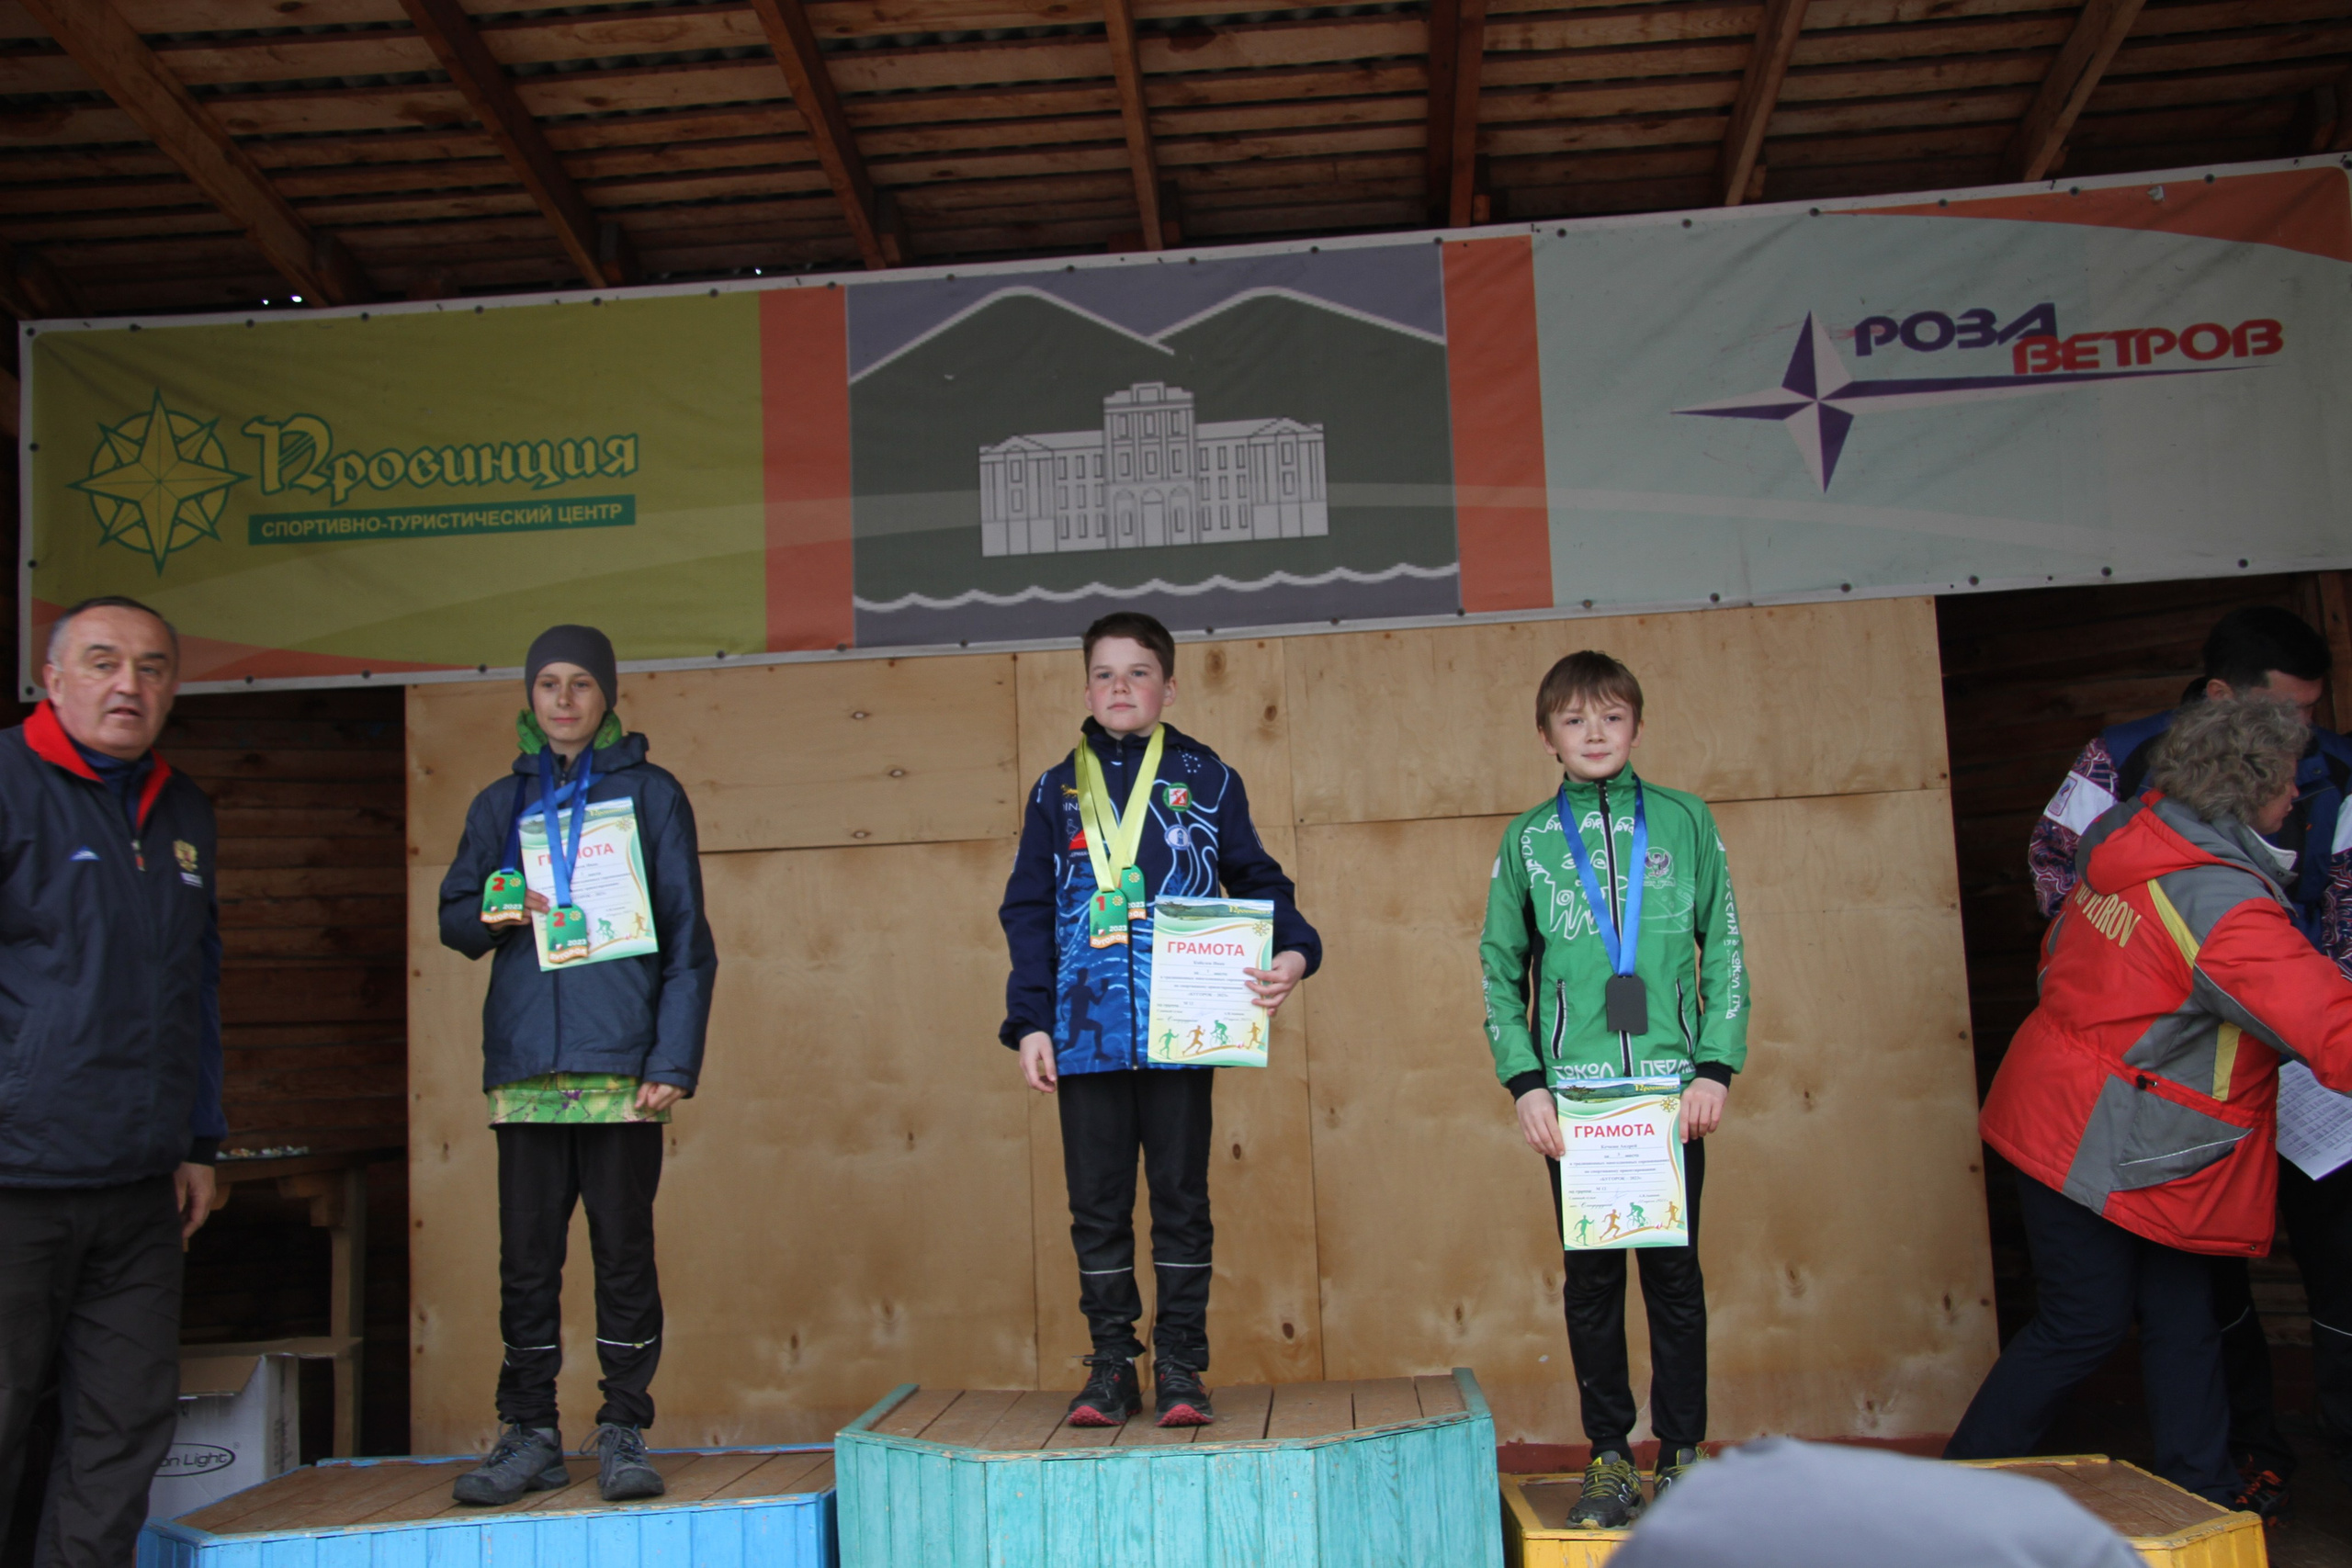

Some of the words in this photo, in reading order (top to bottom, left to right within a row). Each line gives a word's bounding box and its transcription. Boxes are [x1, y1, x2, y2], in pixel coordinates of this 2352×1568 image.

[1854, 302, 2057, 356] РОЗА
[2012, 318, 2284, 375] ВЕТРОВ
[242, 413, 639, 507] Провинция
[262, 505, 552, 537] СПОРТИВНО-ТУРИСТИЧЕСКИЙ
[558, 503, 623, 526] ЦЕНТР
[537, 842, 615, 866] ГОТА
[492, 876, 505, 892] 2
[1096, 895, 1106, 911] 1
[553, 911, 566, 928] 2
[1167, 942, 1245, 956] ГРАМОТА
[1574, 1123, 1656, 1138] ГРАМОТА
[159, 1457, 180, 1467] on
[184, 1451, 227, 1468] Light
